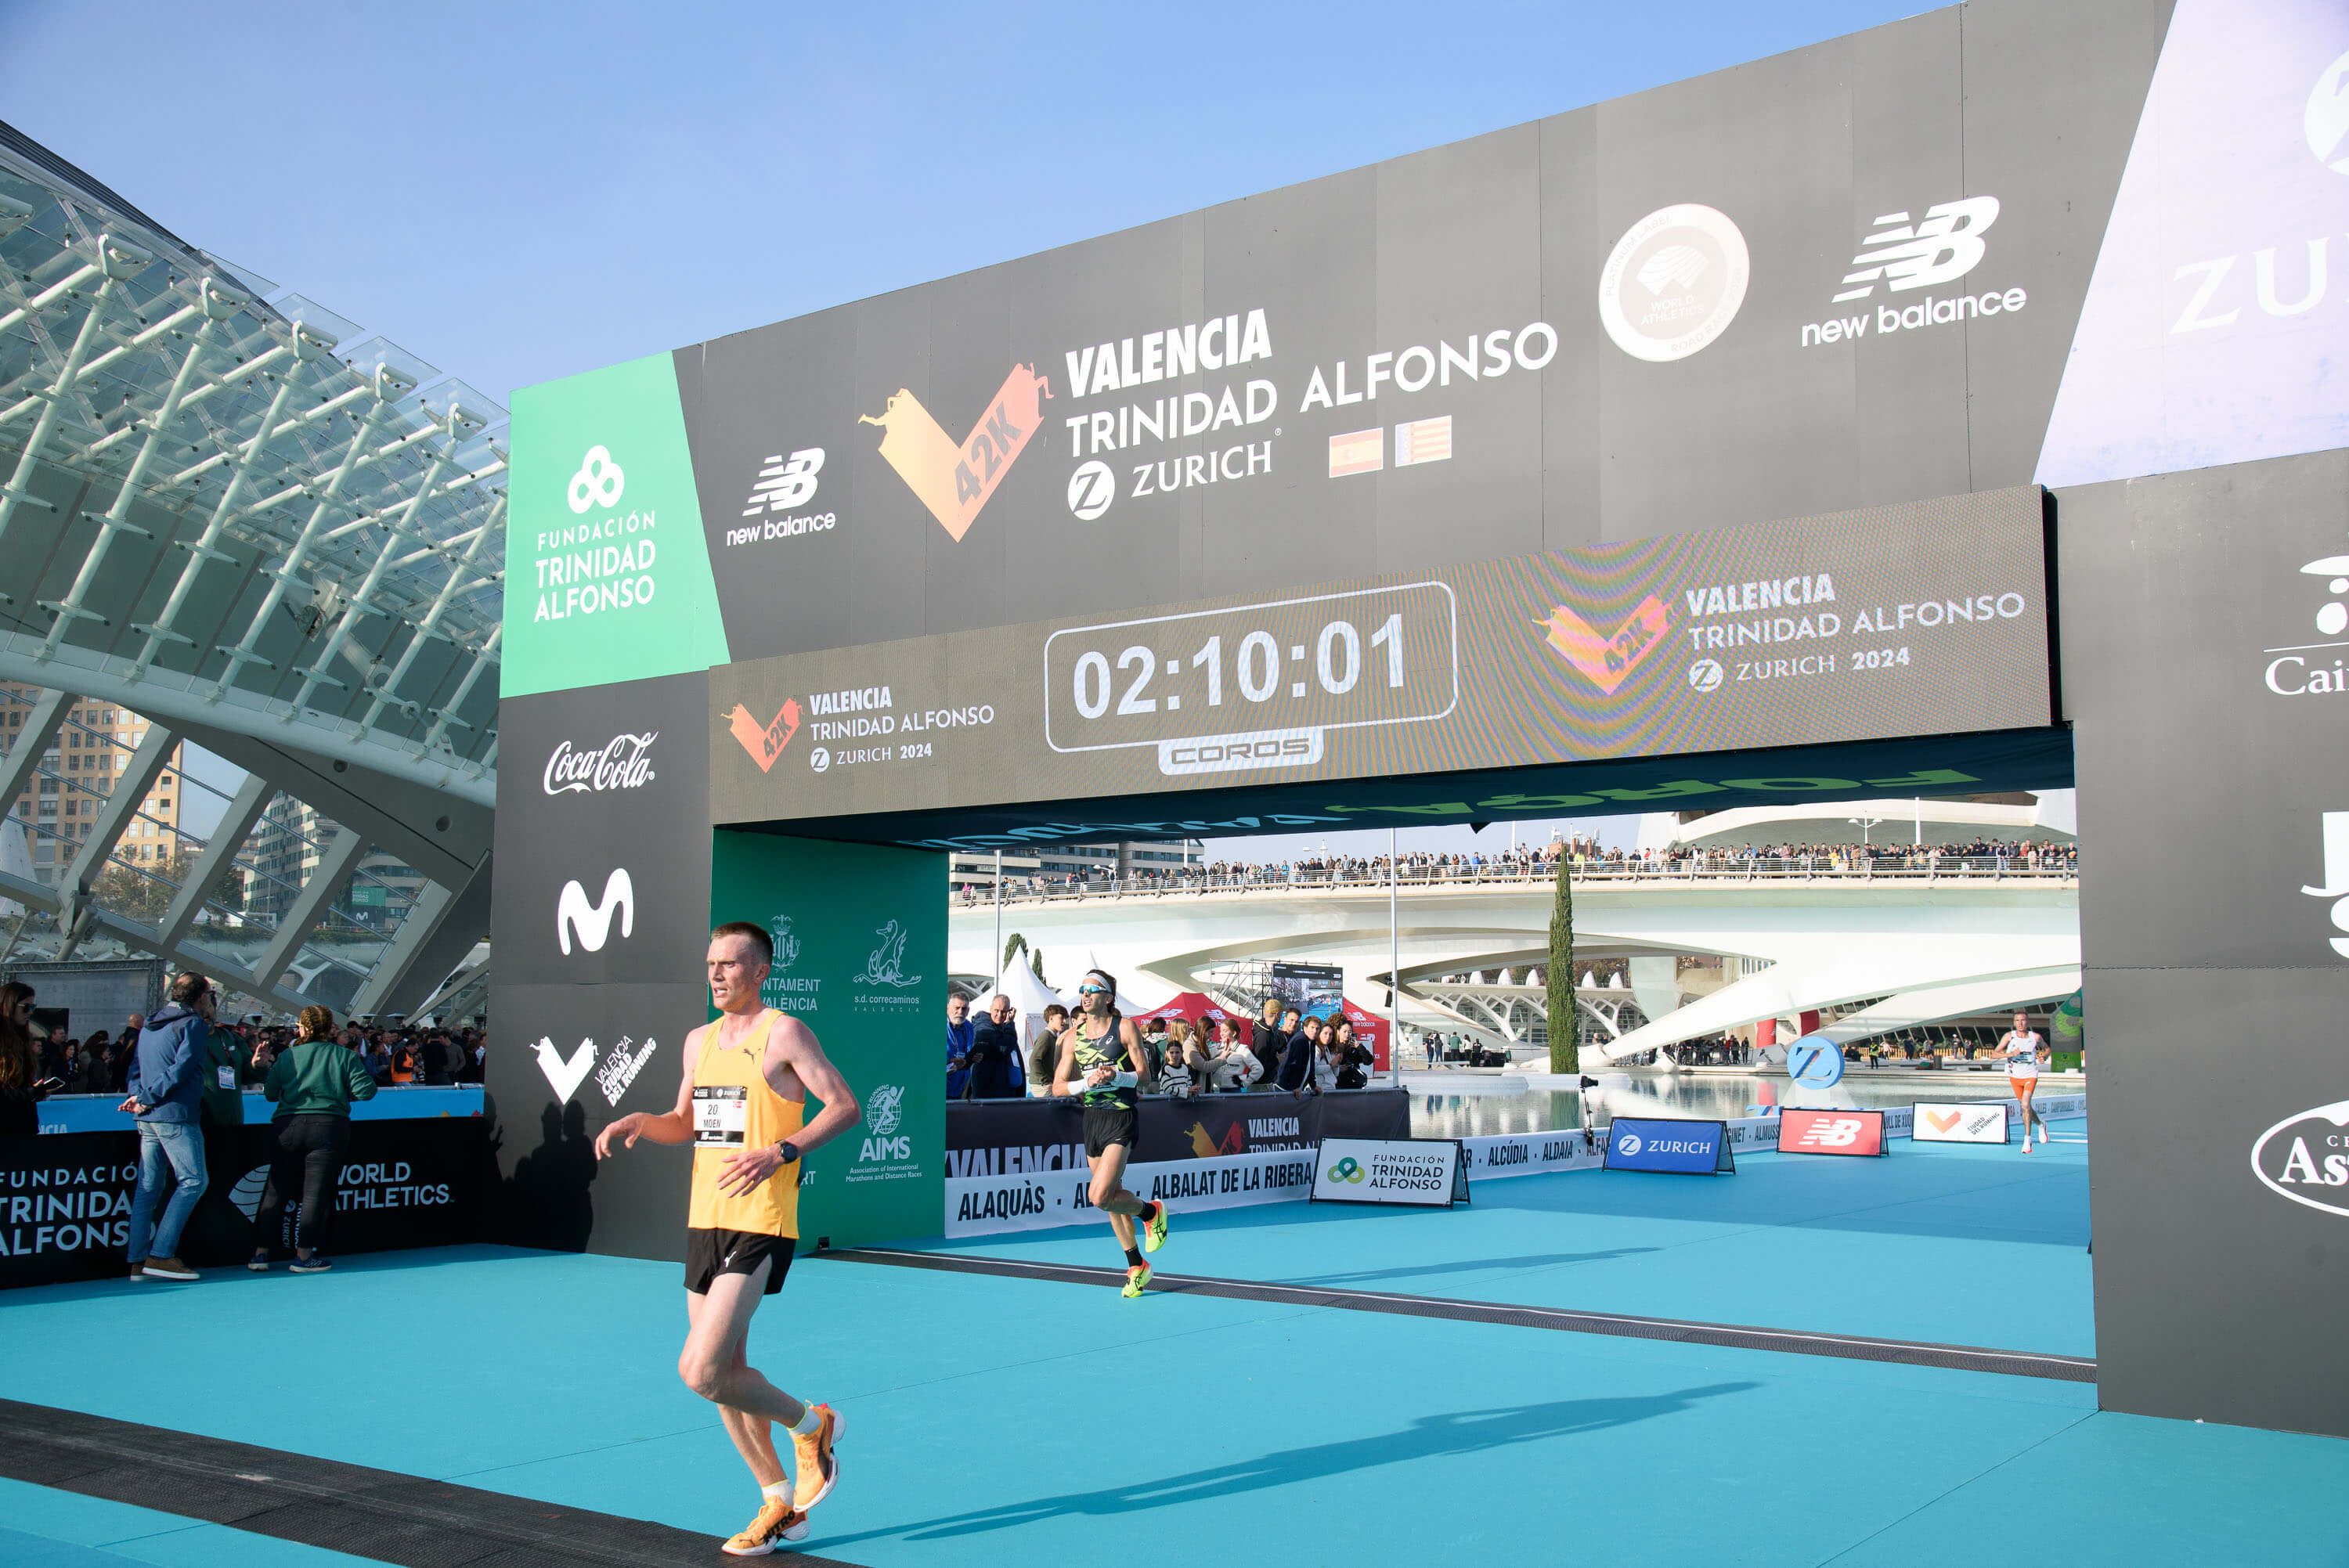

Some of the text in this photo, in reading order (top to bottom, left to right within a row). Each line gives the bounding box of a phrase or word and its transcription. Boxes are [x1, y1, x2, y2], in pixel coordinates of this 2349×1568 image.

[2168, 233, 2349, 335] ZU
[1802, 287, 2027, 347] new balance
[1066, 308, 1272, 398] VALENCIA
[1066, 322, 1558, 457] TRINIDAD ALFONSO
[954, 397, 1024, 507] 42K
[1131, 441, 1272, 499] ZURICH
[536, 509, 657, 553] FUNDACIÓN
[727, 511, 836, 546] new balance
[535, 539, 656, 589] TRINIDAD
[533, 575, 655, 622] ALFONSO
[1686, 573, 1835, 617] VALENCIA
[1688, 593, 2025, 651] TRINIDAD ALFONSO
[1073, 613, 1405, 719] 02:10:01
[1736, 654, 1835, 682] ZURICH
[1851, 647, 1910, 671] 2024
[2265, 657, 2349, 695] Cai
[810, 687, 893, 716] VALENCIA
[810, 705, 994, 741] TRINIDAD ALFONSO
[837, 747, 891, 765] ZURICH
[900, 743, 932, 759] 2024
[1171, 738, 1309, 765] COROS
[763, 978, 821, 992] NTAMENT
[869, 995, 919, 1004] correcaminos
[595, 1035, 633, 1085] VALENCIA
[601, 1053, 633, 1096] CIUDAD
[608, 1037, 656, 1107] DEL RUNNING
[708, 1105, 718, 1115] 20
[1248, 1117, 1300, 1138] VALENCIA
[859, 1136, 911, 1162] AIMS
[1373, 1154, 1445, 1164] FUNDACIÓN
[1488, 1140, 1528, 1166] ALCÚDIA
[1543, 1141, 1573, 1162] ALDAIA
[1586, 1136, 1610, 1156] ALFA
[1728, 1127, 1746, 1144] GINET
[1755, 1124, 1780, 1141] ALMUSS
[1647, 1139, 1710, 1154] ZURICH
[2278, 1137, 2349, 1186] As
[0, 1162, 138, 1188] UNDACIÓ
[850, 1165, 879, 1174] Association
[1369, 1179, 1442, 1190] ALFONSO
[1372, 1164, 1443, 1178] TRINIDAD
[0, 1190, 132, 1224] RINIDA
[336, 1184, 450, 1211] THLETICS
[958, 1180, 1045, 1221] ALAQUÀS
[1151, 1170, 1217, 1200] ALBALAT
[1221, 1168, 1239, 1193] DE
[1243, 1166, 1260, 1191] LA
[1265, 1162, 1312, 1189] RIBERA
[0, 1220, 156, 1256] LFONS
